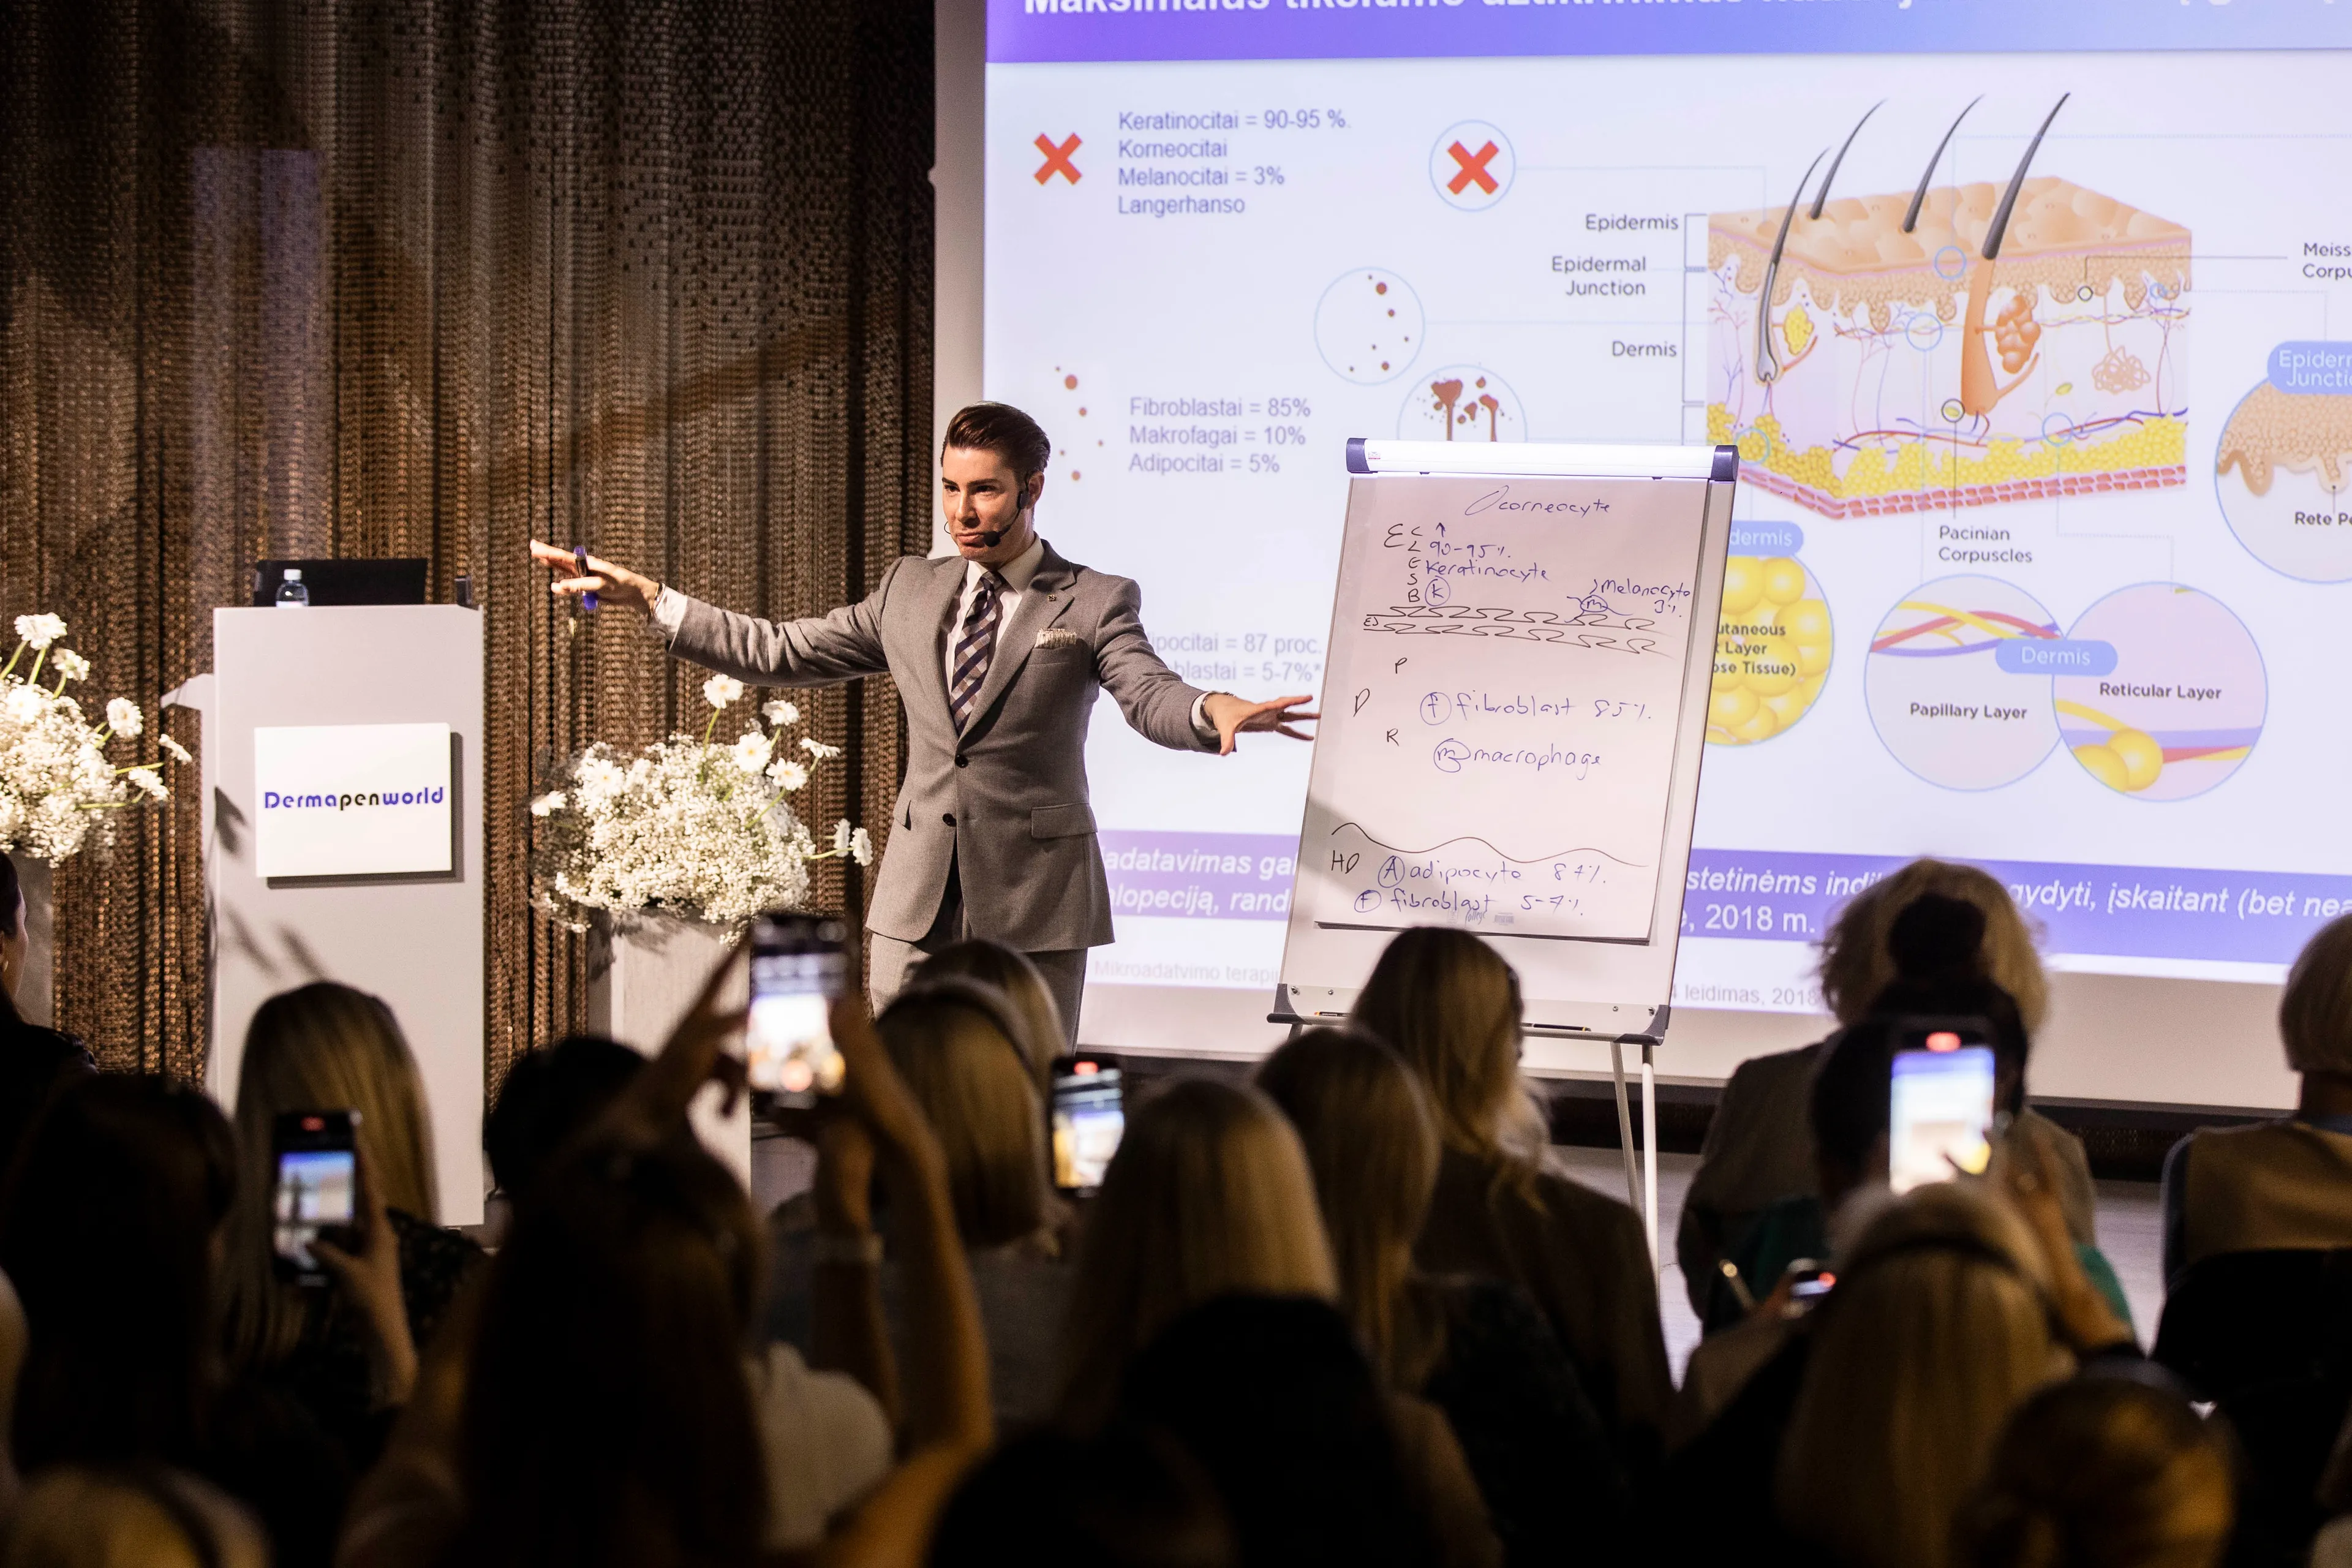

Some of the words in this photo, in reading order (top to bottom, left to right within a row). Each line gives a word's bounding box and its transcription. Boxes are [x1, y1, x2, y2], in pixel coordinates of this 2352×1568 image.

[1118, 110, 1238, 130] Keratinocitai
[1264, 108, 1321, 129] 90-95
[1118, 140, 1227, 159] Korneocitai
[1118, 167, 1228, 187] Melanocitai
[1254, 167, 1285, 185] 3%
[1118, 196, 1245, 218] Langerhanso
[1586, 214, 1678, 232] Epidermis
[1552, 256, 1646, 274] Epidermal
[1566, 280, 1646, 296] Junction
[1612, 341, 1677, 356] Dermis
[2286, 369, 2352, 387] Juncti
[1129, 397, 1242, 417] Fibroblastai
[1268, 398, 1311, 417] 85%
[1129, 426, 1237, 448] Makrofagai
[1265, 426, 1306, 446] 10%
[1128, 453, 1223, 475] Adipocitai
[1249, 454, 1280, 473] 5%
[1729, 528, 1793, 547] dermis
[1939, 526, 2010, 540] Pacinian
[1939, 547, 2032, 563] Corpuscles
[1408, 589, 1420, 602] B
[1717, 623, 1786, 636] utaneous
[1148, 631, 1219, 655] ipocitai
[1244, 633, 1268, 653] 87
[1275, 638, 1322, 657] proc.
[1725, 642, 1767, 656] Layer
[2022, 646, 2090, 666] Dermis
[1713, 663, 1736, 673] ose
[1743, 661, 1796, 676] Tissue)
[2100, 682, 2172, 698] Reticular
[2177, 685, 2222, 699] Layer
[1910, 703, 1978, 720] Papillary
[1984, 705, 2027, 720] Layer
[264, 786, 444, 811] Dermapenworld
[1101, 846, 1252, 874] adatavimas
[1230, 889, 1291, 912] rand
[1687, 867, 1817, 895] stetinėms
[2237, 888, 2296, 920] (bet
[1705, 903, 1772, 931] 2018
[1783, 913, 1815, 933] m.
